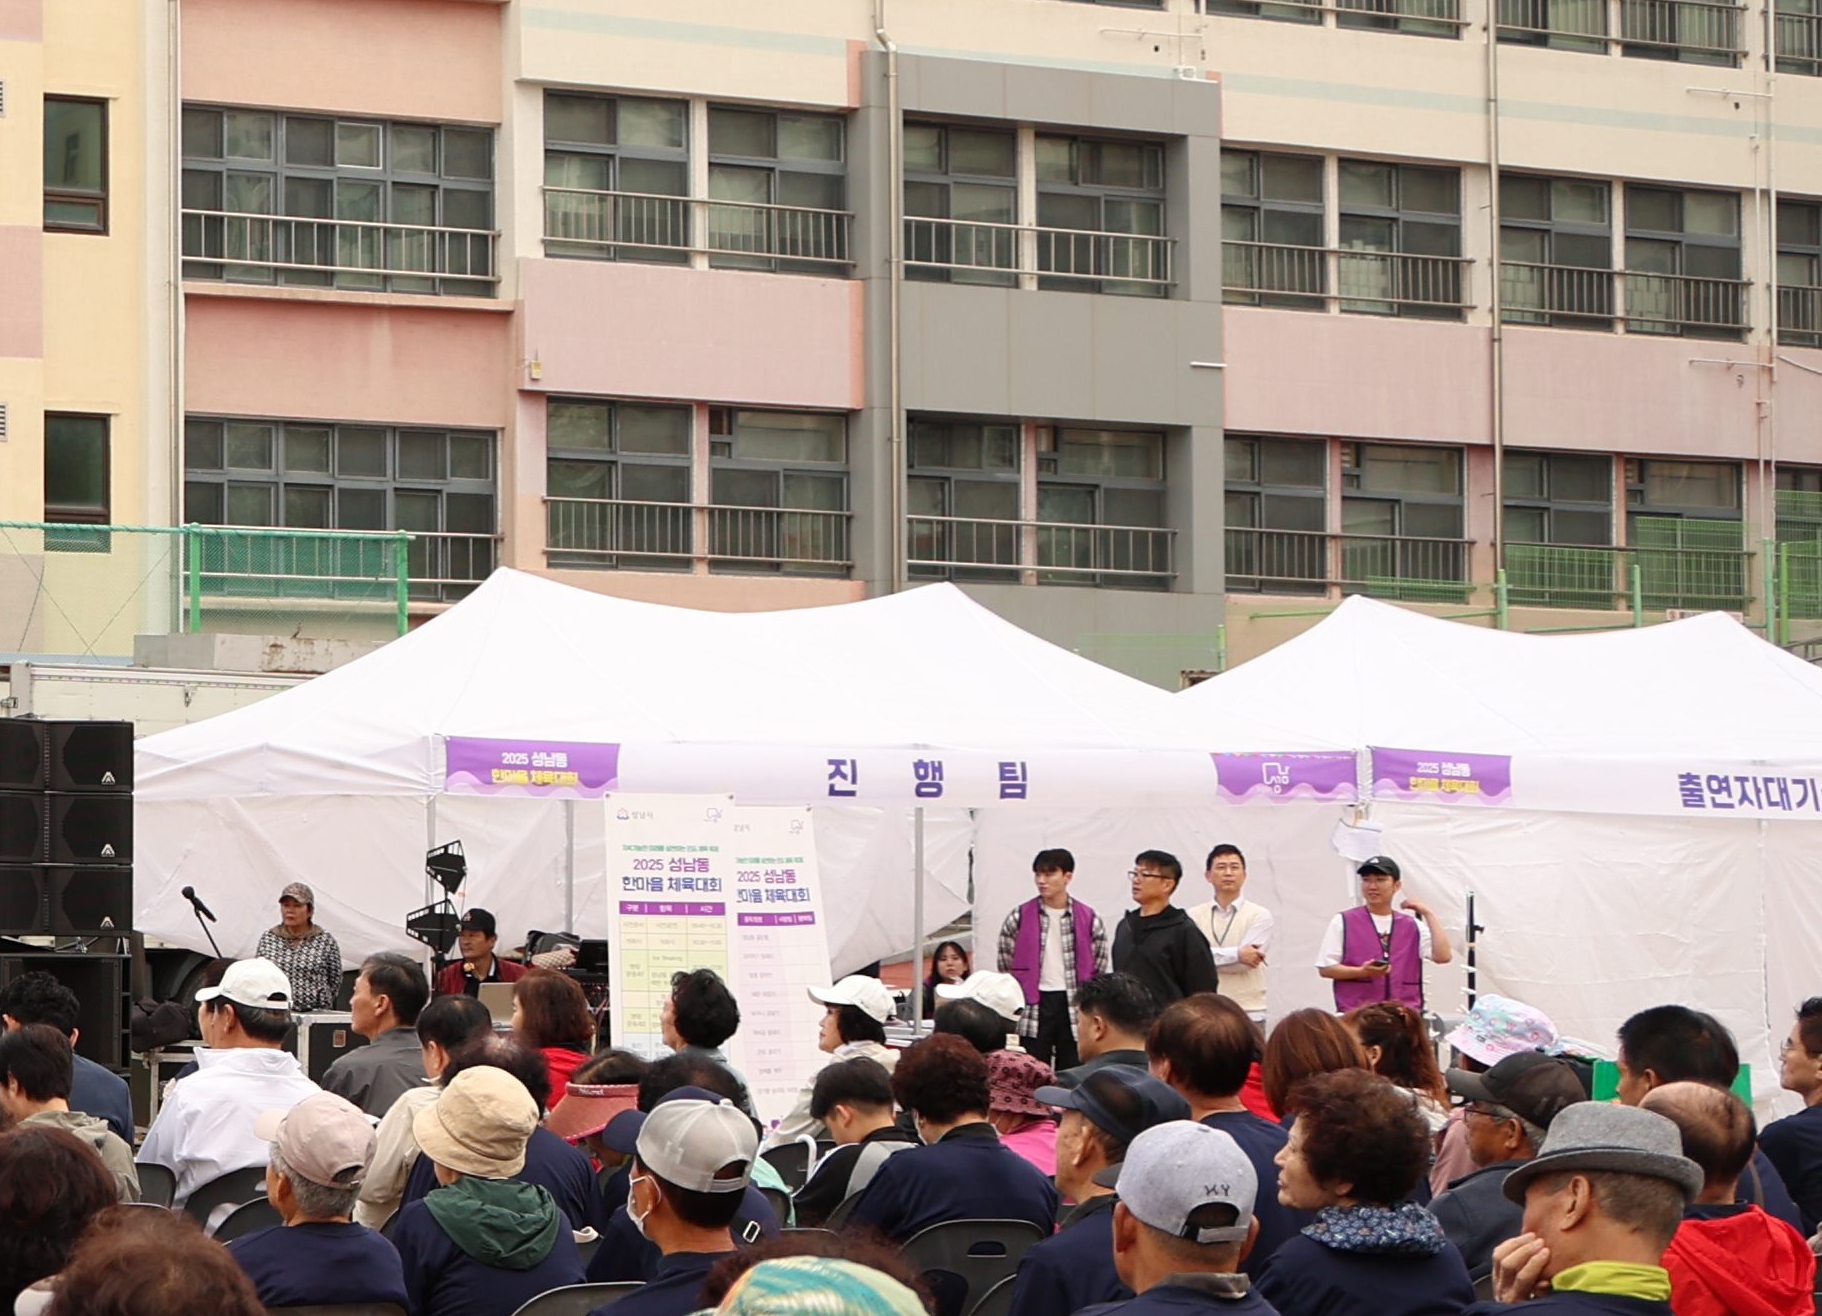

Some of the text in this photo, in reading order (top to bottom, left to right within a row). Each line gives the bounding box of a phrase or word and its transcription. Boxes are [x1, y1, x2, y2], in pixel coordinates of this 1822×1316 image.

[502, 752, 568, 768] 2025 성남동
[1417, 762, 1439, 774] 2025
[1678, 772, 1822, 811] 출연자대기
[633, 857, 710, 873] 2025 성남동
[622, 876, 722, 892] 한마음 체육대회
[737, 869, 796, 884] 2025 성남동
[765, 888, 810, 903] 체육대회
